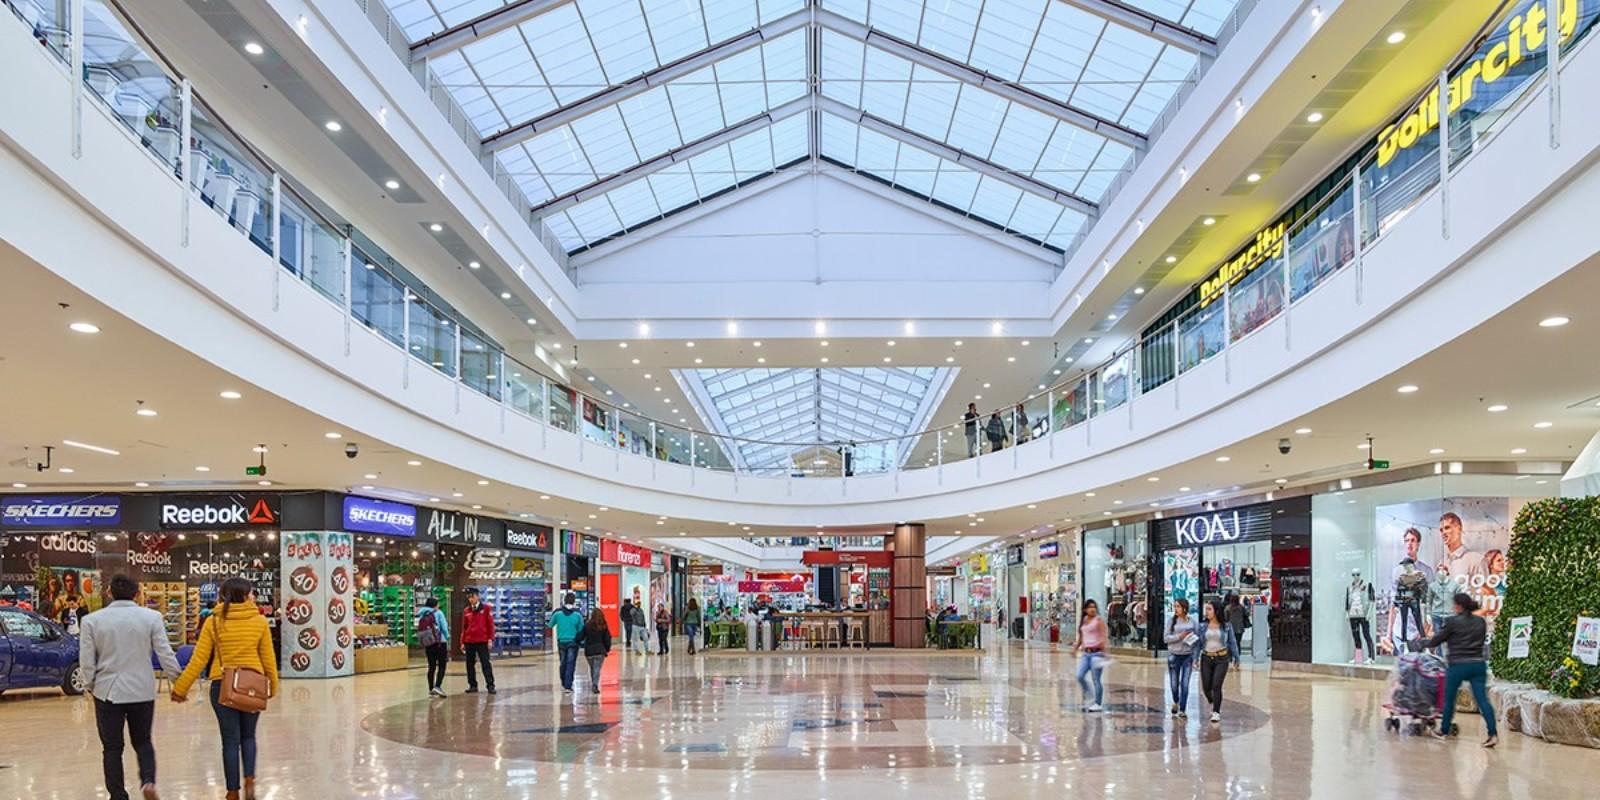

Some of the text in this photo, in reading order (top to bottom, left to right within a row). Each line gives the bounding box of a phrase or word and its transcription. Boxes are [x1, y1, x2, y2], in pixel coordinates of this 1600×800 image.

[1200, 222, 1284, 309] Dollarcity
[4, 504, 118, 518] SKECHERS
[162, 504, 247, 524] Reebok
[349, 506, 416, 527] SKECHERS
[427, 509, 479, 542] ALL IN
[1175, 510, 1240, 545] KOAJ
[41, 531, 97, 554] adidas
[507, 529, 538, 547] Reebok
[126, 549, 172, 566] Reebok
[189, 559, 249, 575] Reebok
[468, 570, 544, 580] SKECHERS
